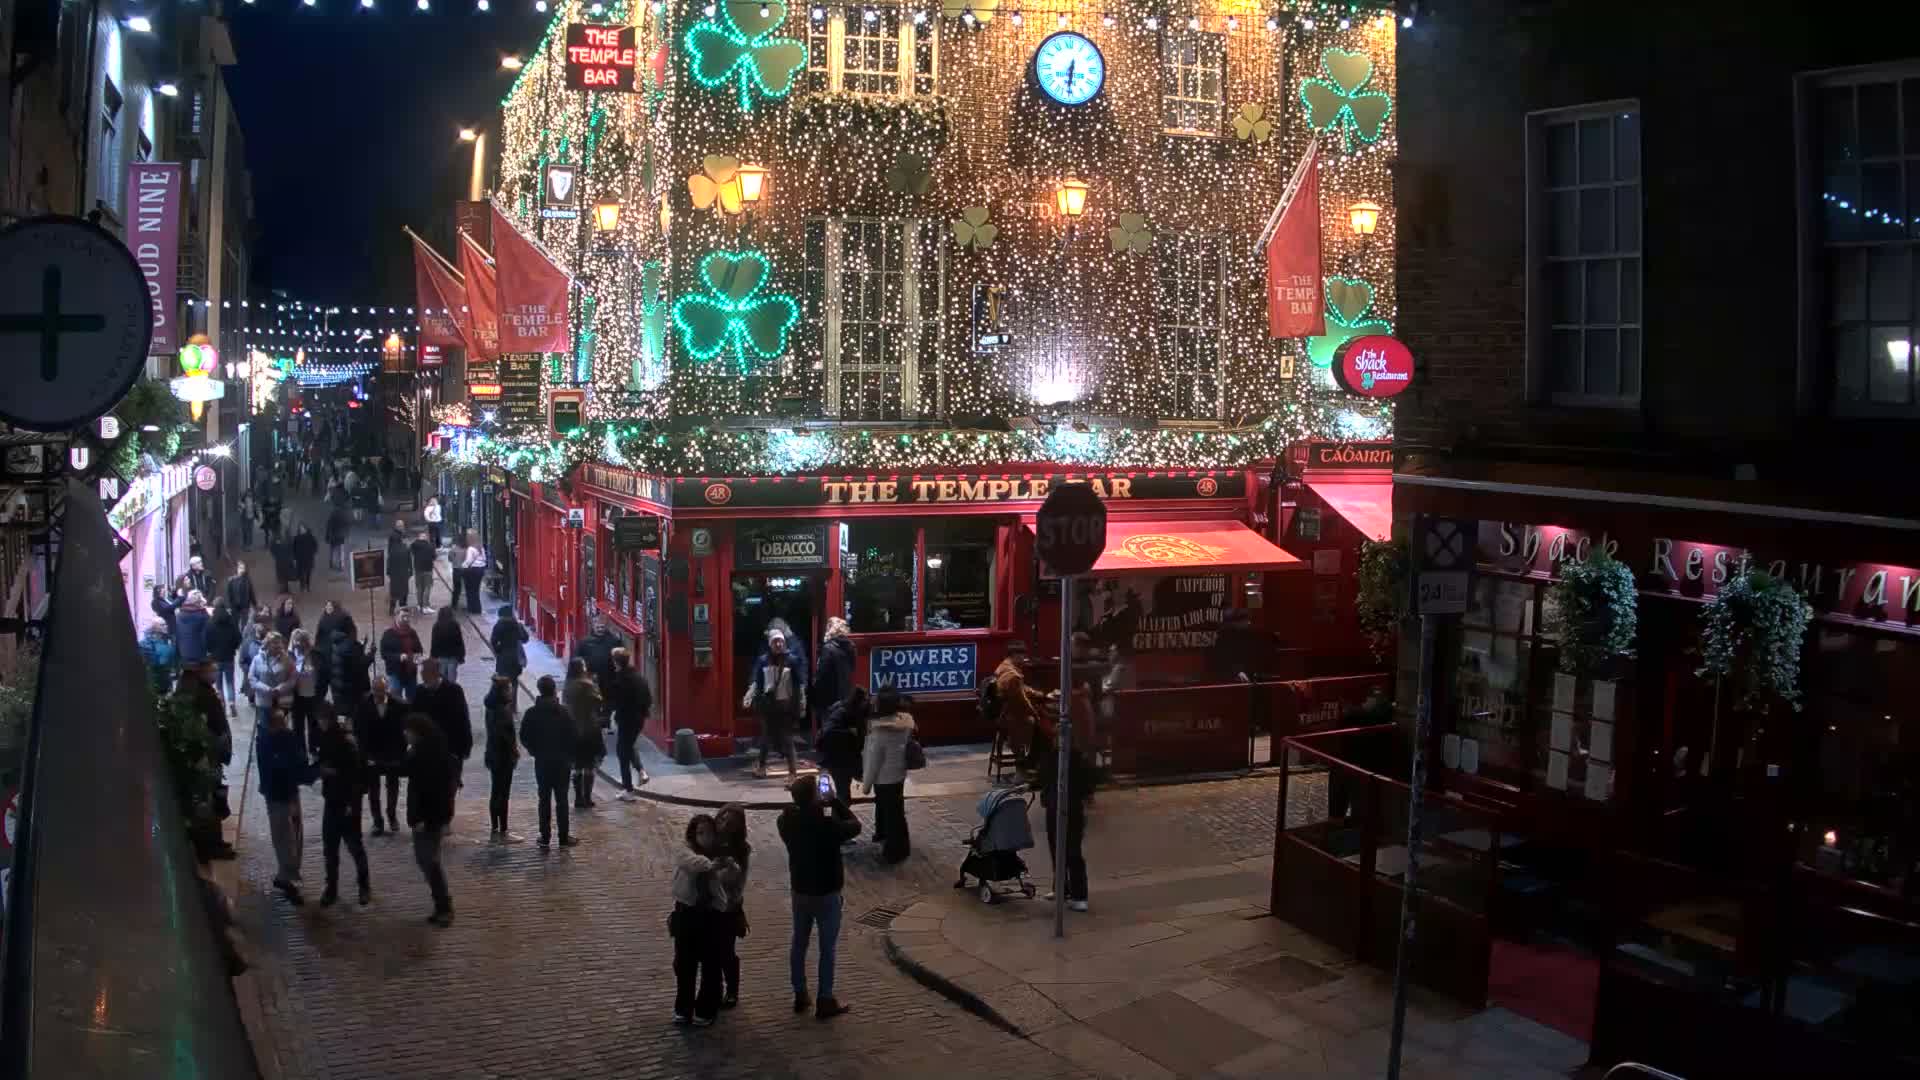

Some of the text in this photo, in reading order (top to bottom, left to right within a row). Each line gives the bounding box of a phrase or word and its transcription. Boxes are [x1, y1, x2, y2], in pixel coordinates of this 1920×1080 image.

[585, 29, 619, 46] THE
[568, 47, 634, 65] TEMPLE
[584, 69, 618, 86] BAR
[139, 171, 170, 233] NINE
[1291, 275, 1313, 286] THE
[519, 304, 547, 314] THE
[503, 313, 563, 326] TEMPLE
[518, 326, 549, 337] BAR
[1355, 350, 1388, 377] Shack
[1372, 371, 1409, 381] Restaurant
[823, 482, 899, 503] THE
[912, 479, 1050, 501] TEMPLE
[1039, 515, 1104, 547] STOP
[752, 537, 817, 561] TOBACCO
[1499, 521, 1619, 566] Shack
[879, 647, 969, 667] POWER'S
[873, 669, 974, 689] WHISKEY
